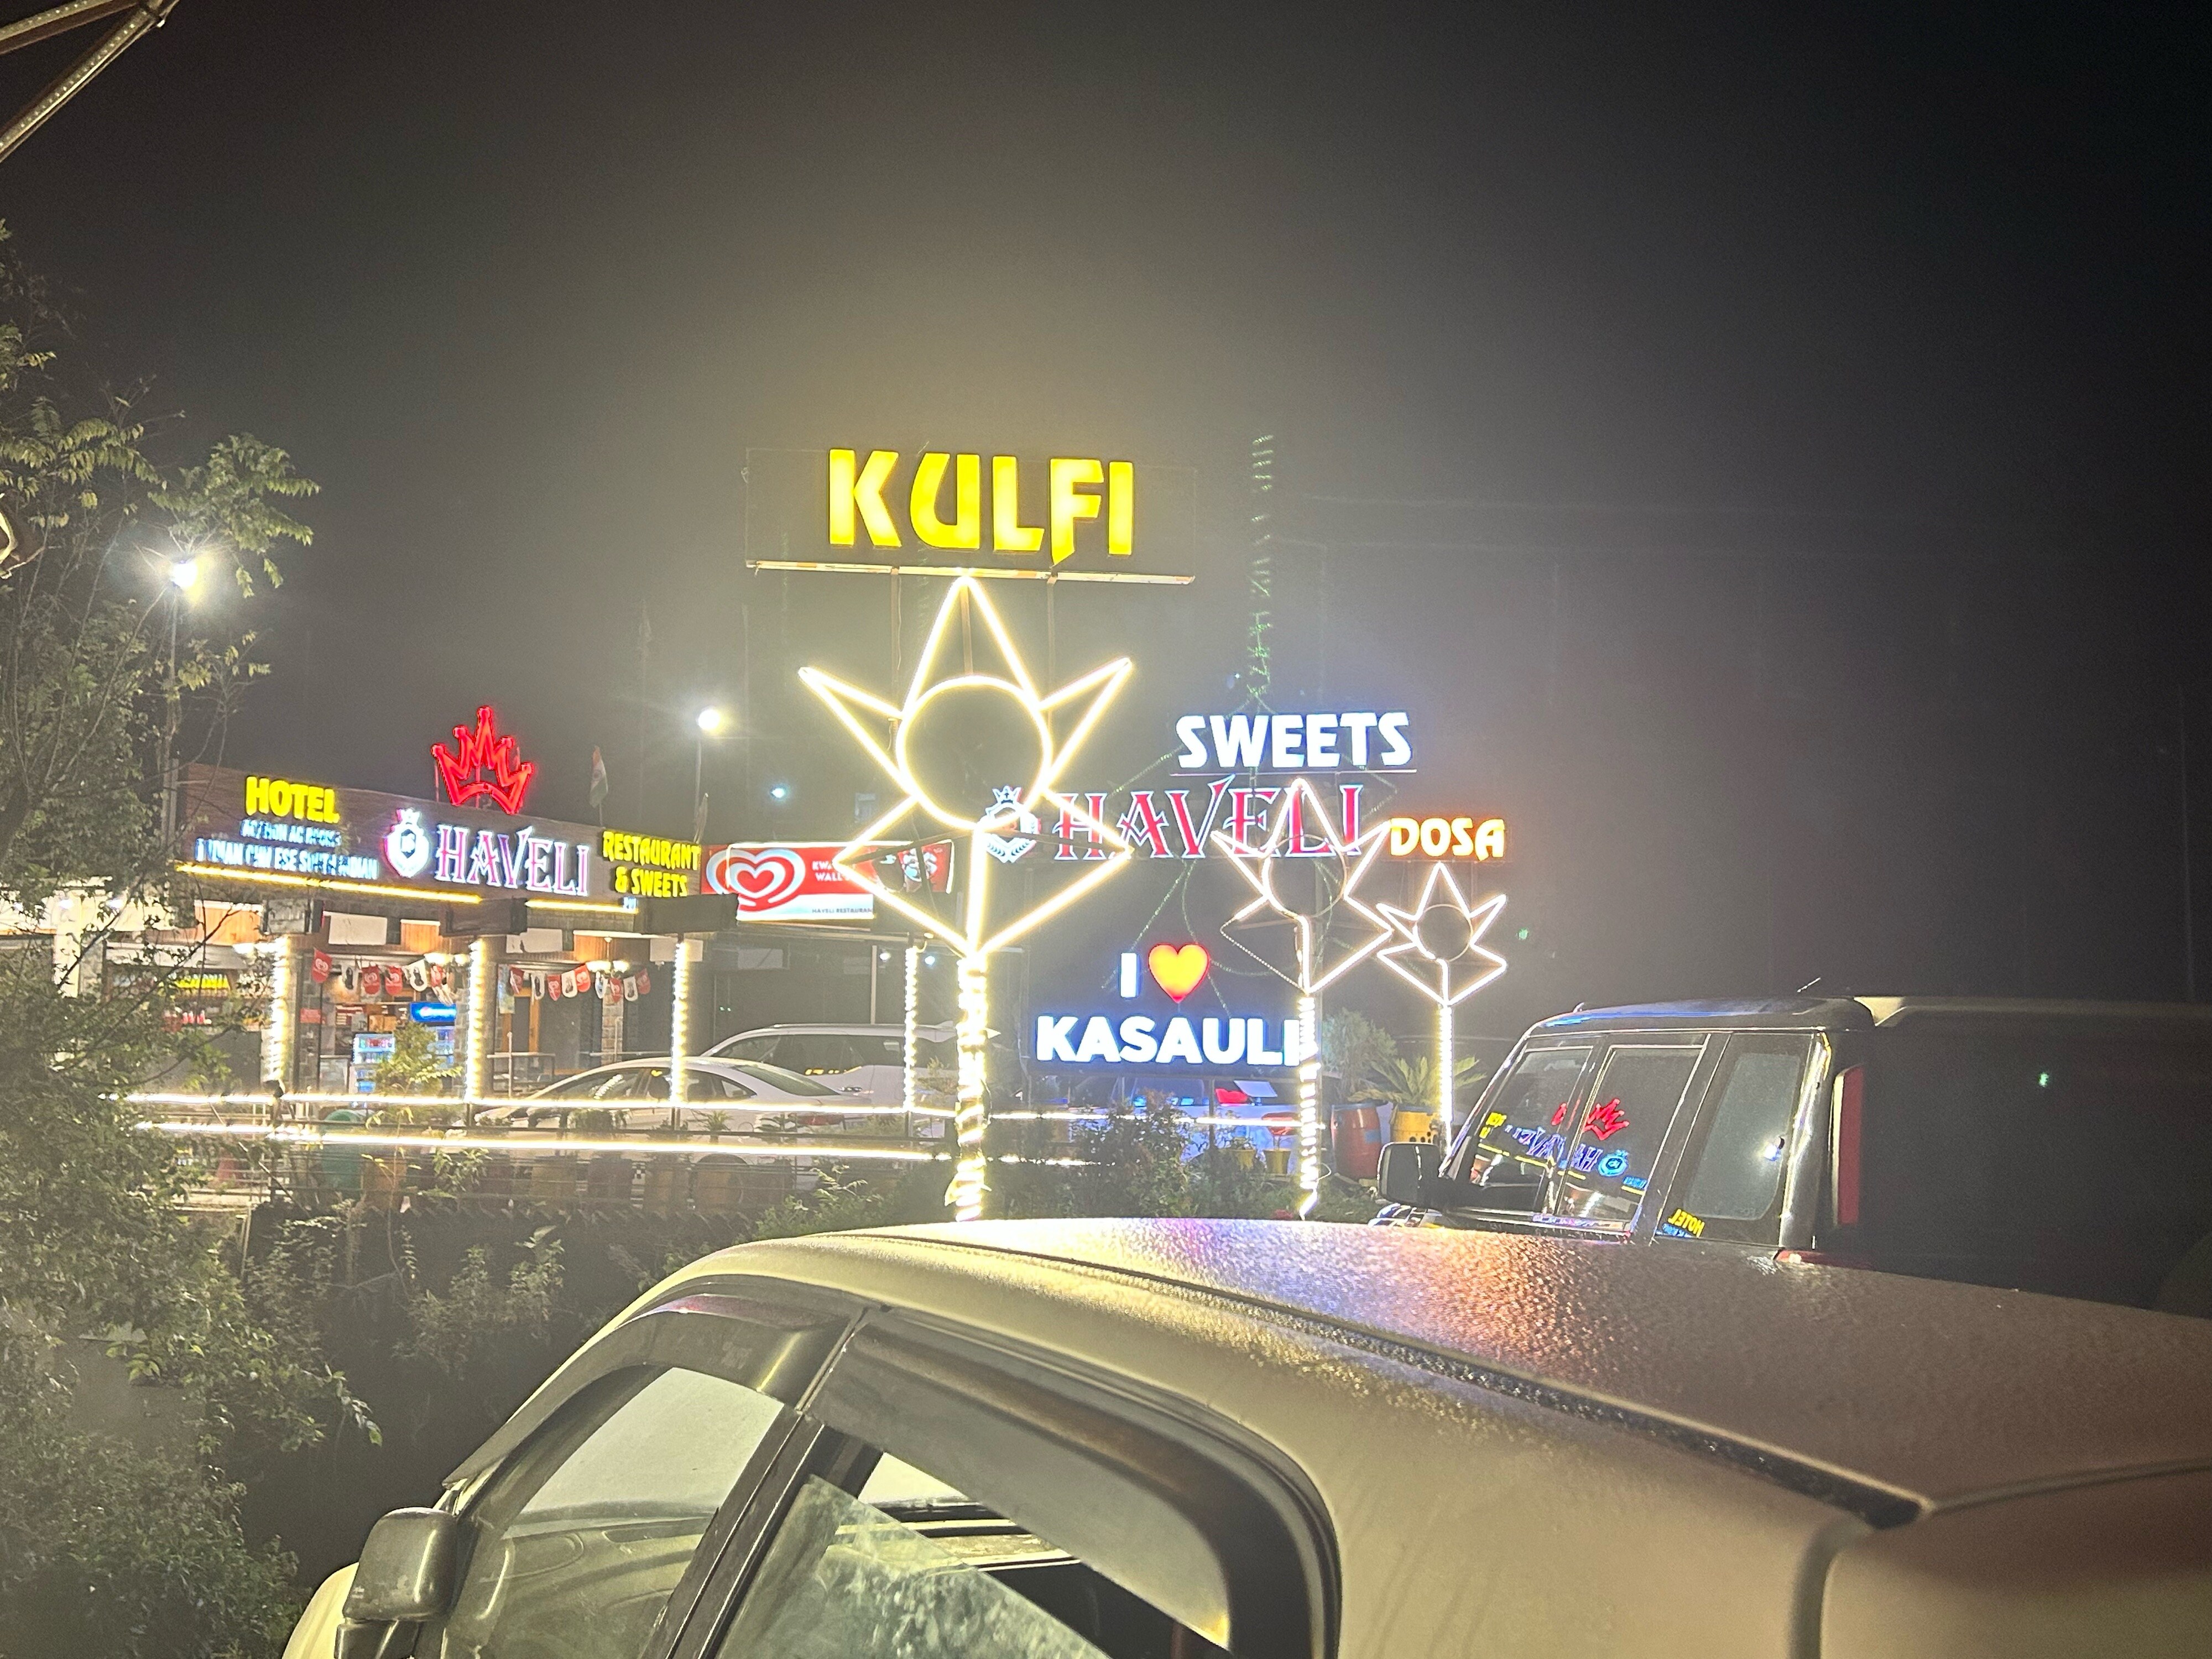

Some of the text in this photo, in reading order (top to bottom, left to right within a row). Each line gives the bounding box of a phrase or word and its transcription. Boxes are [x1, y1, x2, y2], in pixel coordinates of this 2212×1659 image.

[829, 448, 1134, 566] KULFI
[1176, 712, 1412, 769] SWEETS
[246, 776, 340, 824] HOTEL
[1051, 774, 1364, 860] HAVELI
[436, 826, 589, 897] HAVELI
[603, 831, 702, 871] RESTAURANT
[1390, 817, 1505, 861] DOSA
[615, 866, 688, 898] & SWEETS
[1121, 952, 1136, 998] I
[1036, 1015, 1300, 1066] KASAULI
